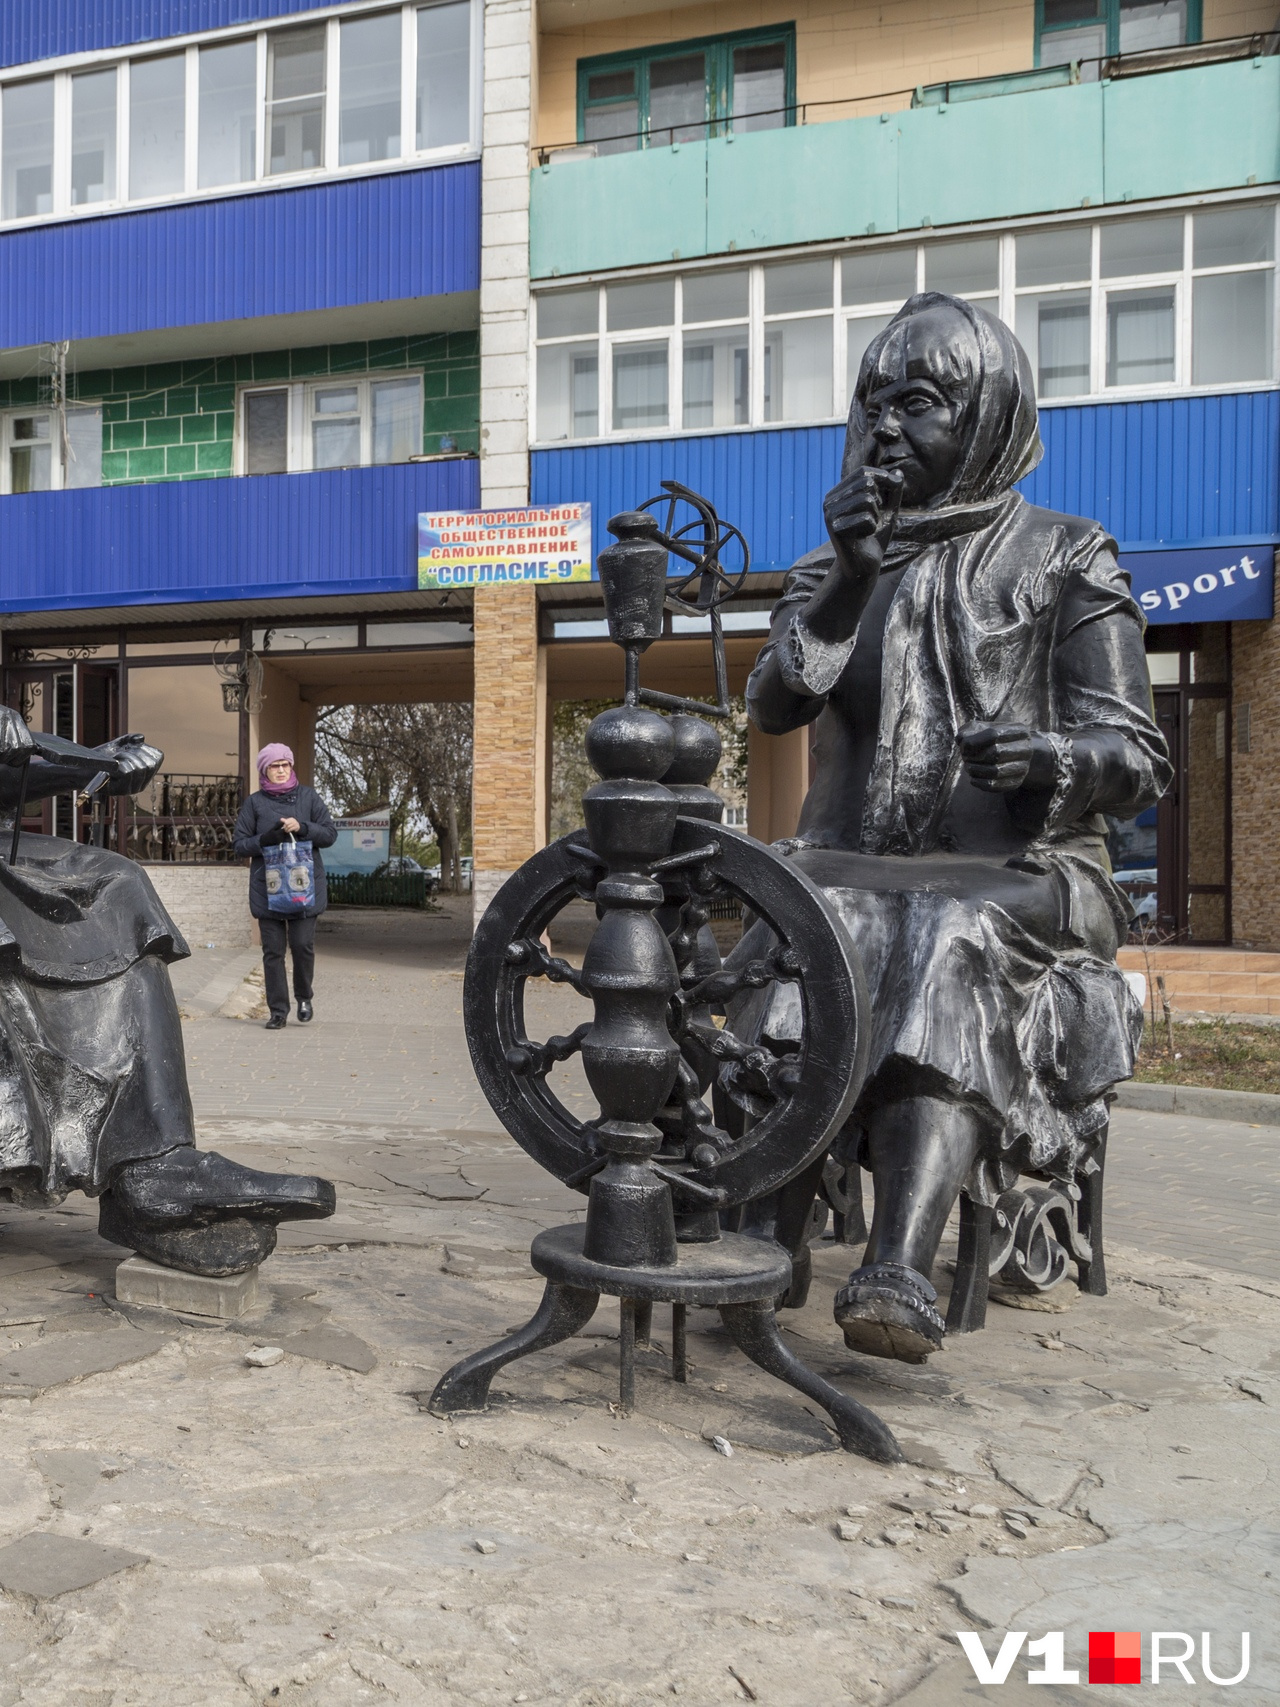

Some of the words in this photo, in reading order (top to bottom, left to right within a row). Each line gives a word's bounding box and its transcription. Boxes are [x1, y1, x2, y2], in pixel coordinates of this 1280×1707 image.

[429, 508, 581, 528] ТЕРРИТОРИАЛЬНОЕ
[440, 525, 568, 544] ОБЩЕСТВЕННОЕ
[431, 540, 579, 560] САМОУПРАВЛЕНИЕ
[1140, 555, 1260, 611] sport
